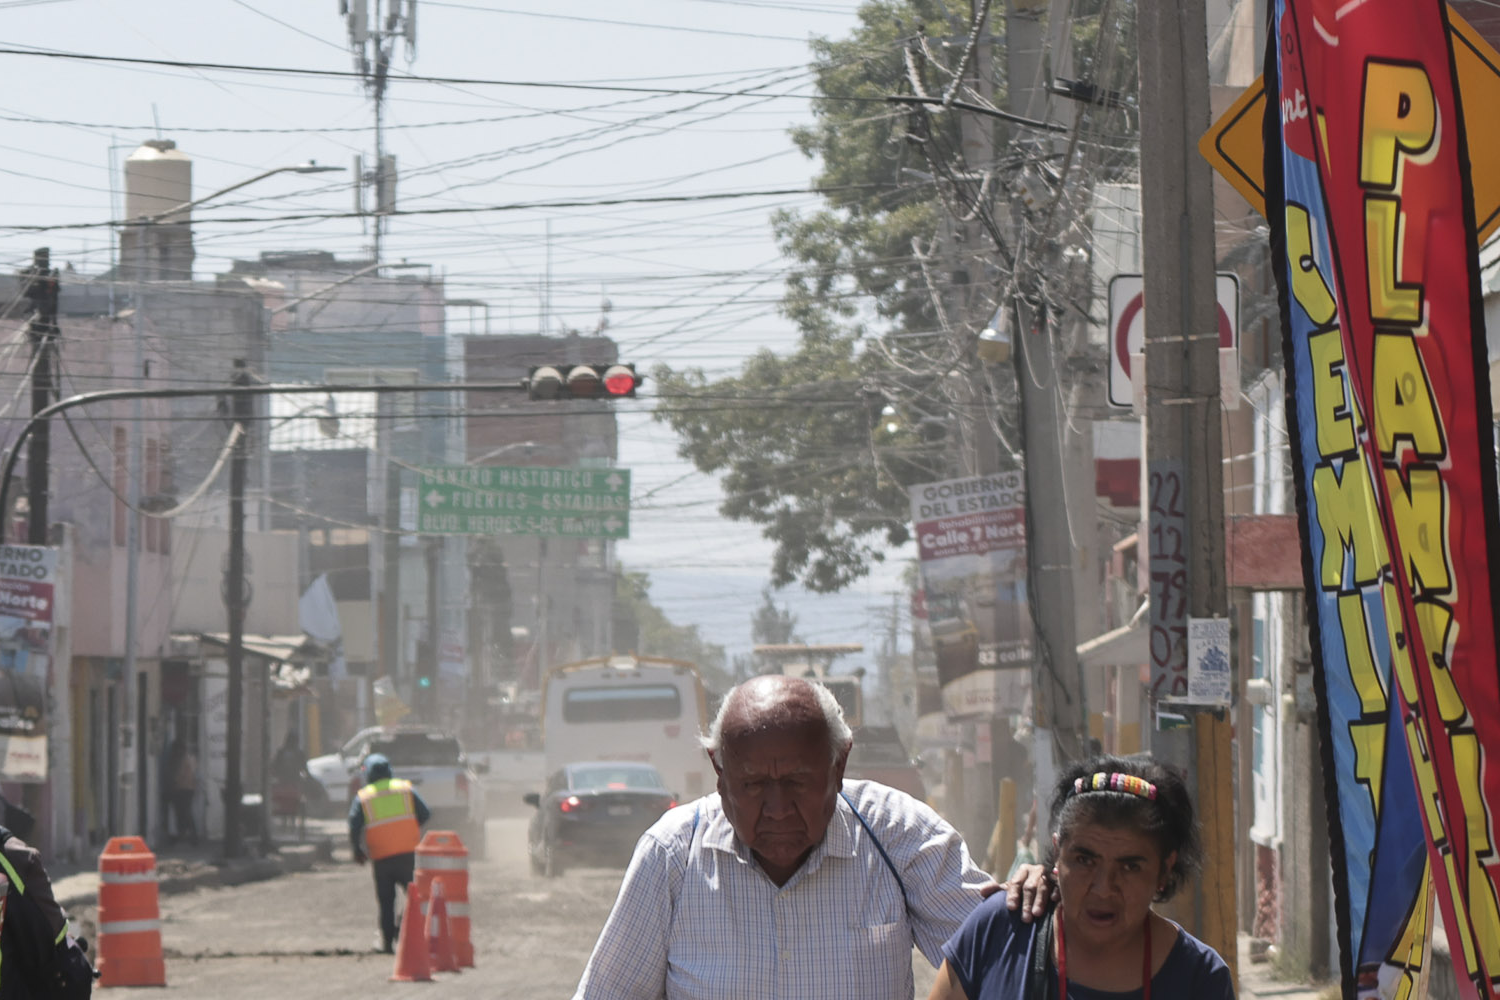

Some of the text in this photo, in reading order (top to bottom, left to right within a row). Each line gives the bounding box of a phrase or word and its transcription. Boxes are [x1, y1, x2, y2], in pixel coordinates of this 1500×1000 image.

[424, 467, 593, 488] CENTRO HISTORICO
[923, 475, 1019, 501] GOBIERNO
[452, 491, 625, 511] FUERTES ESTADIOS
[920, 491, 1026, 518] DEL ESTADO
[1150, 472, 1185, 518] 22
[922, 523, 1025, 548] Calle 7 Nort
[1152, 525, 1185, 565] 12
